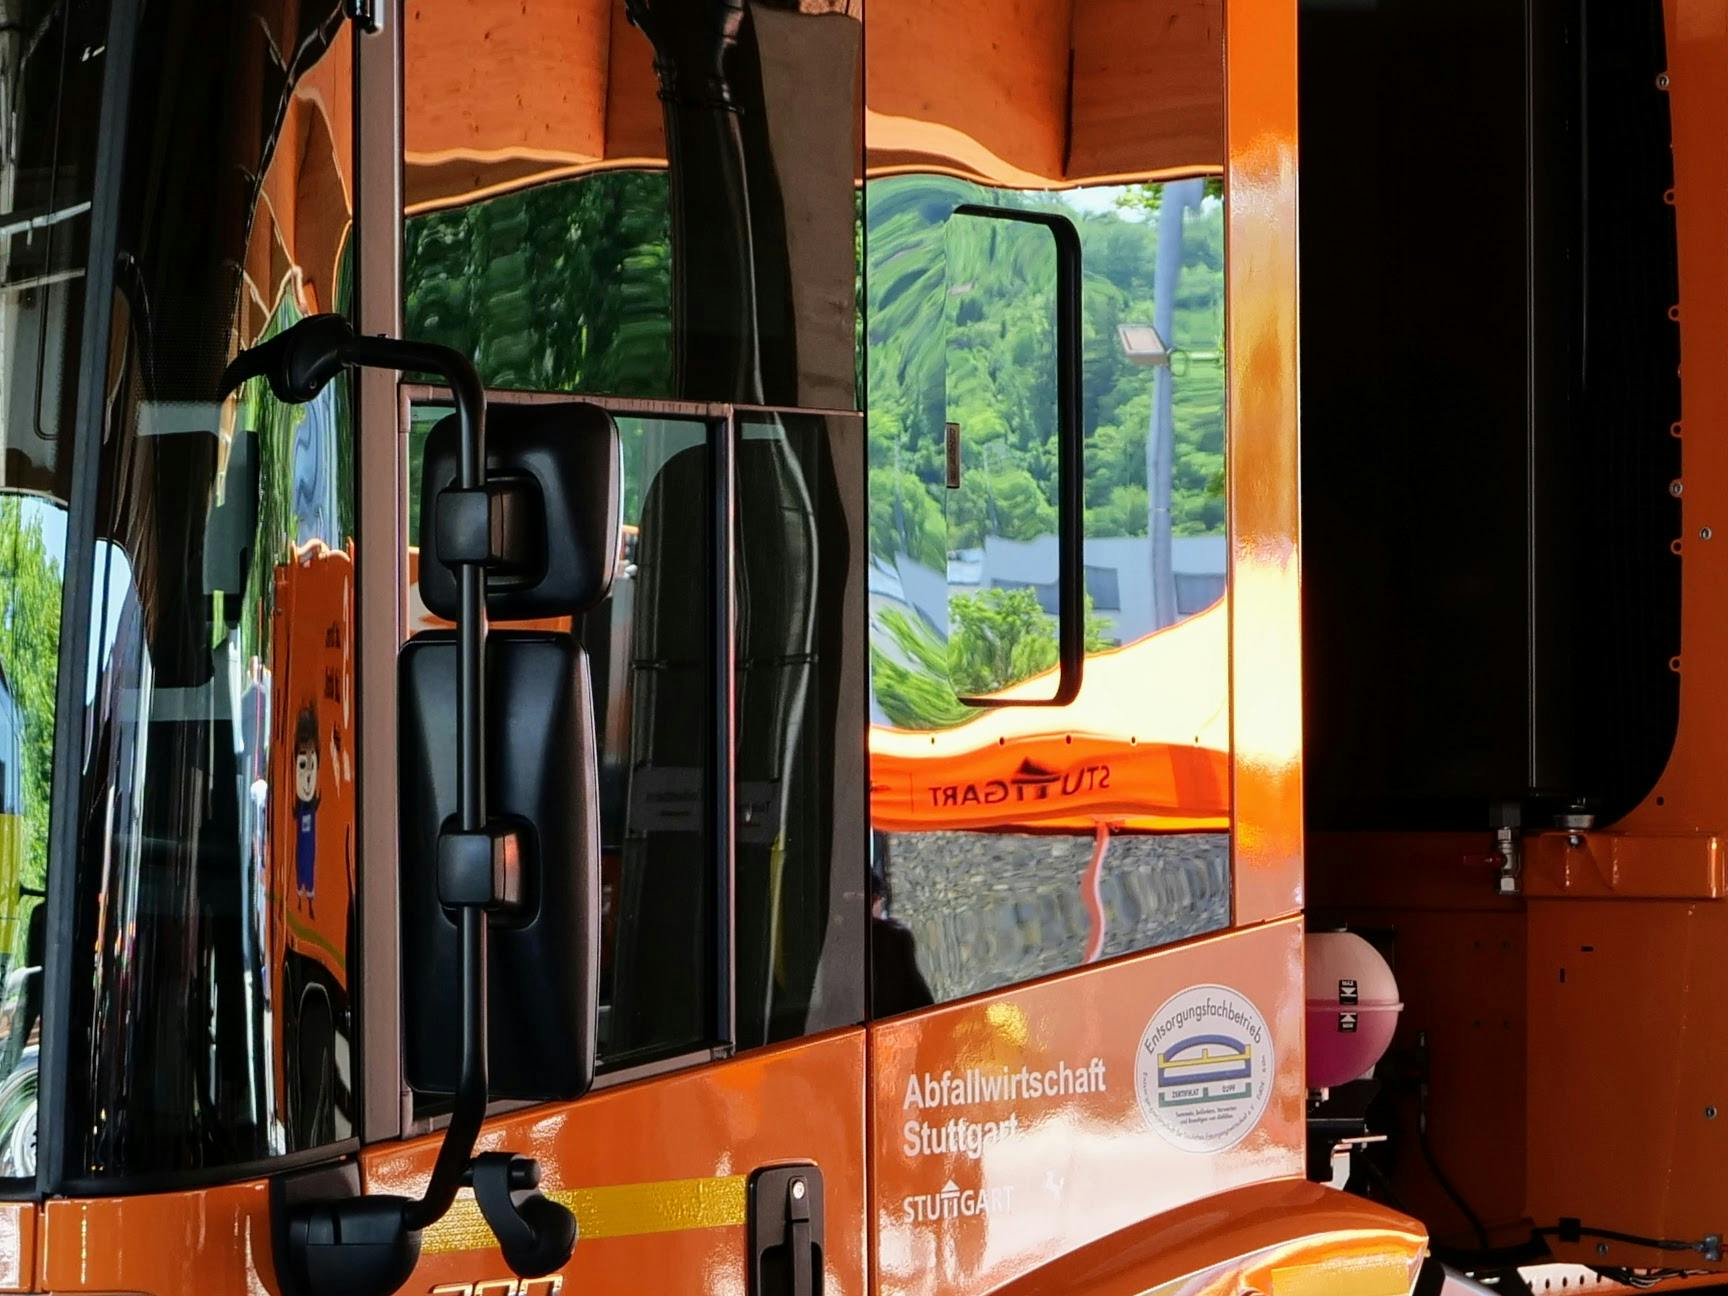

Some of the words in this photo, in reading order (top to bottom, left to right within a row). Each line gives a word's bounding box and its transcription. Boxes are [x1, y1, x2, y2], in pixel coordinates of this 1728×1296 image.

[1144, 997, 1261, 1054] Entsorgungsfachbetrieb
[903, 1057, 1106, 1110] Abfallwirtschaft
[903, 1112, 1018, 1159] Stuttgart
